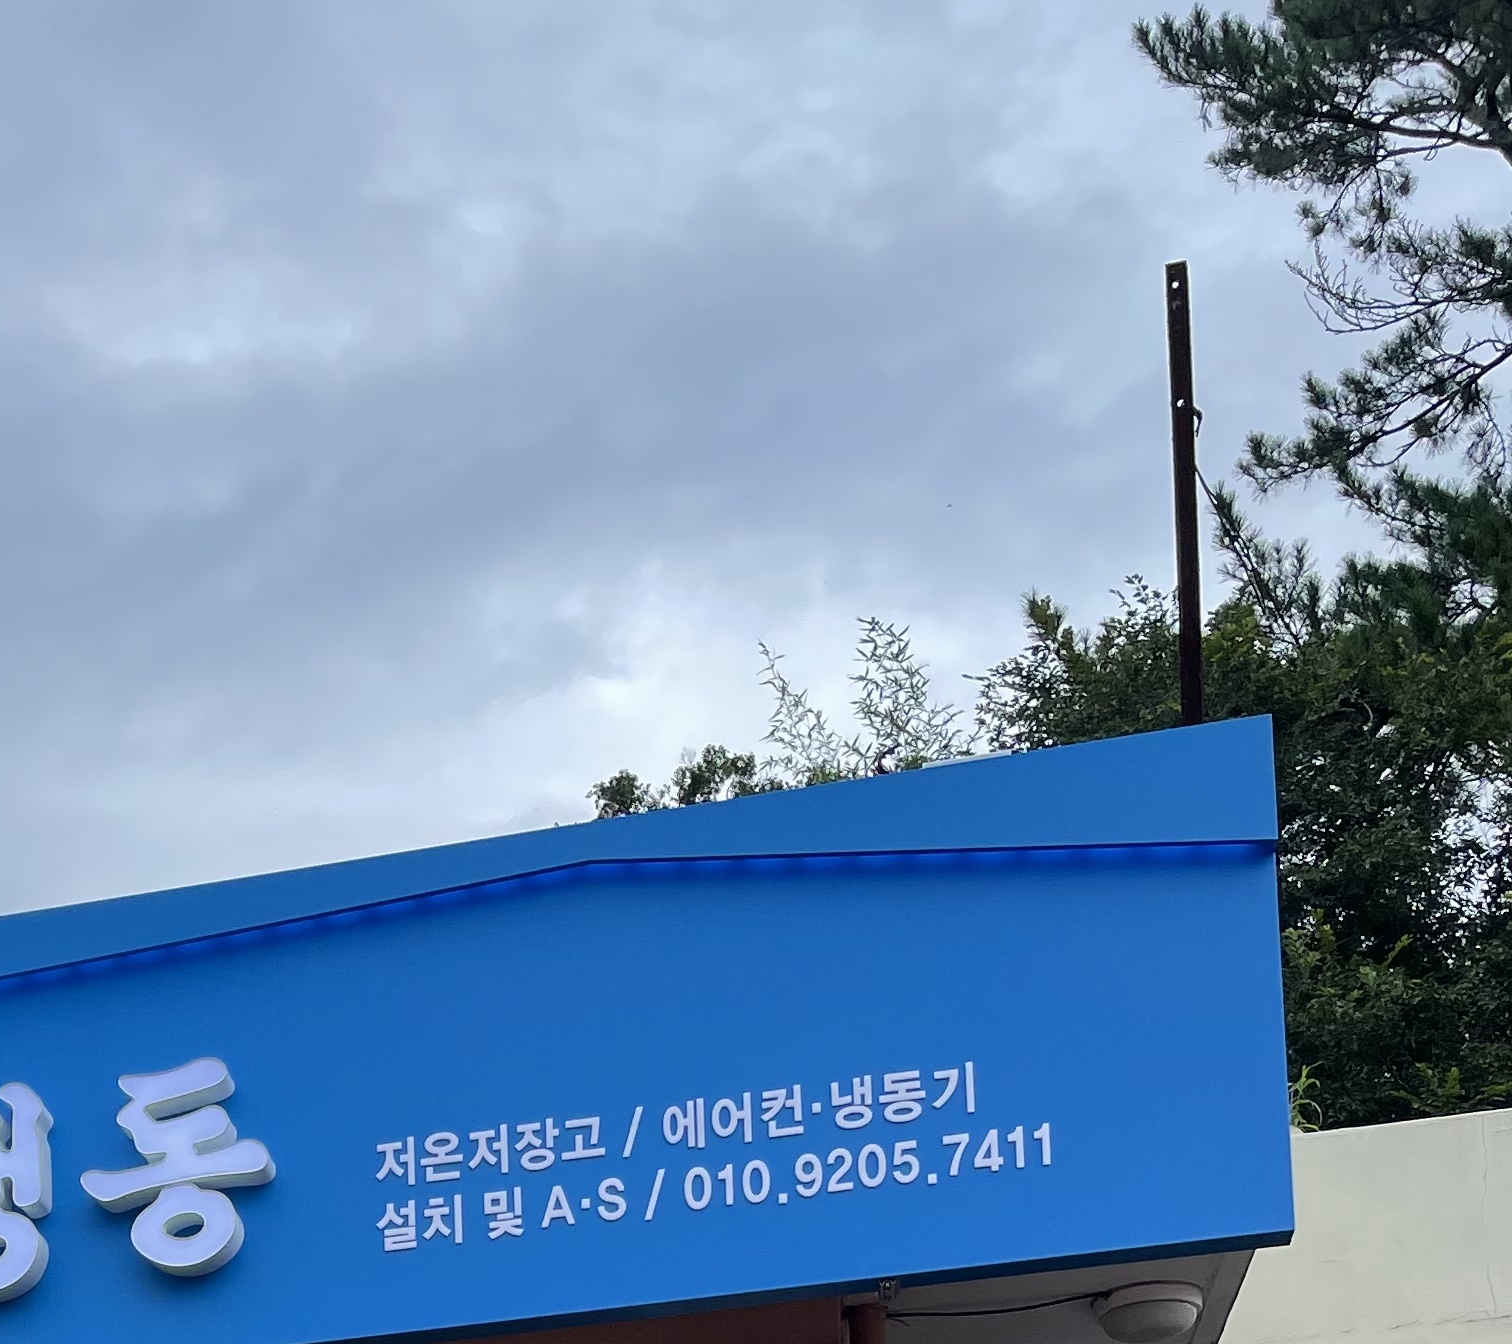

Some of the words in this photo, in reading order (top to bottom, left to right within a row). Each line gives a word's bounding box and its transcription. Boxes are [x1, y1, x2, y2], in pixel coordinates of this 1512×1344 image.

[375, 1114, 606, 1186] 저온저장고
[621, 1105, 645, 1159] /
[375, 1190, 465, 1252] 설치
[483, 1184, 525, 1240] 및
[643, 1168, 667, 1221] /
[682, 1121, 1055, 1211] 010.9205.7411
